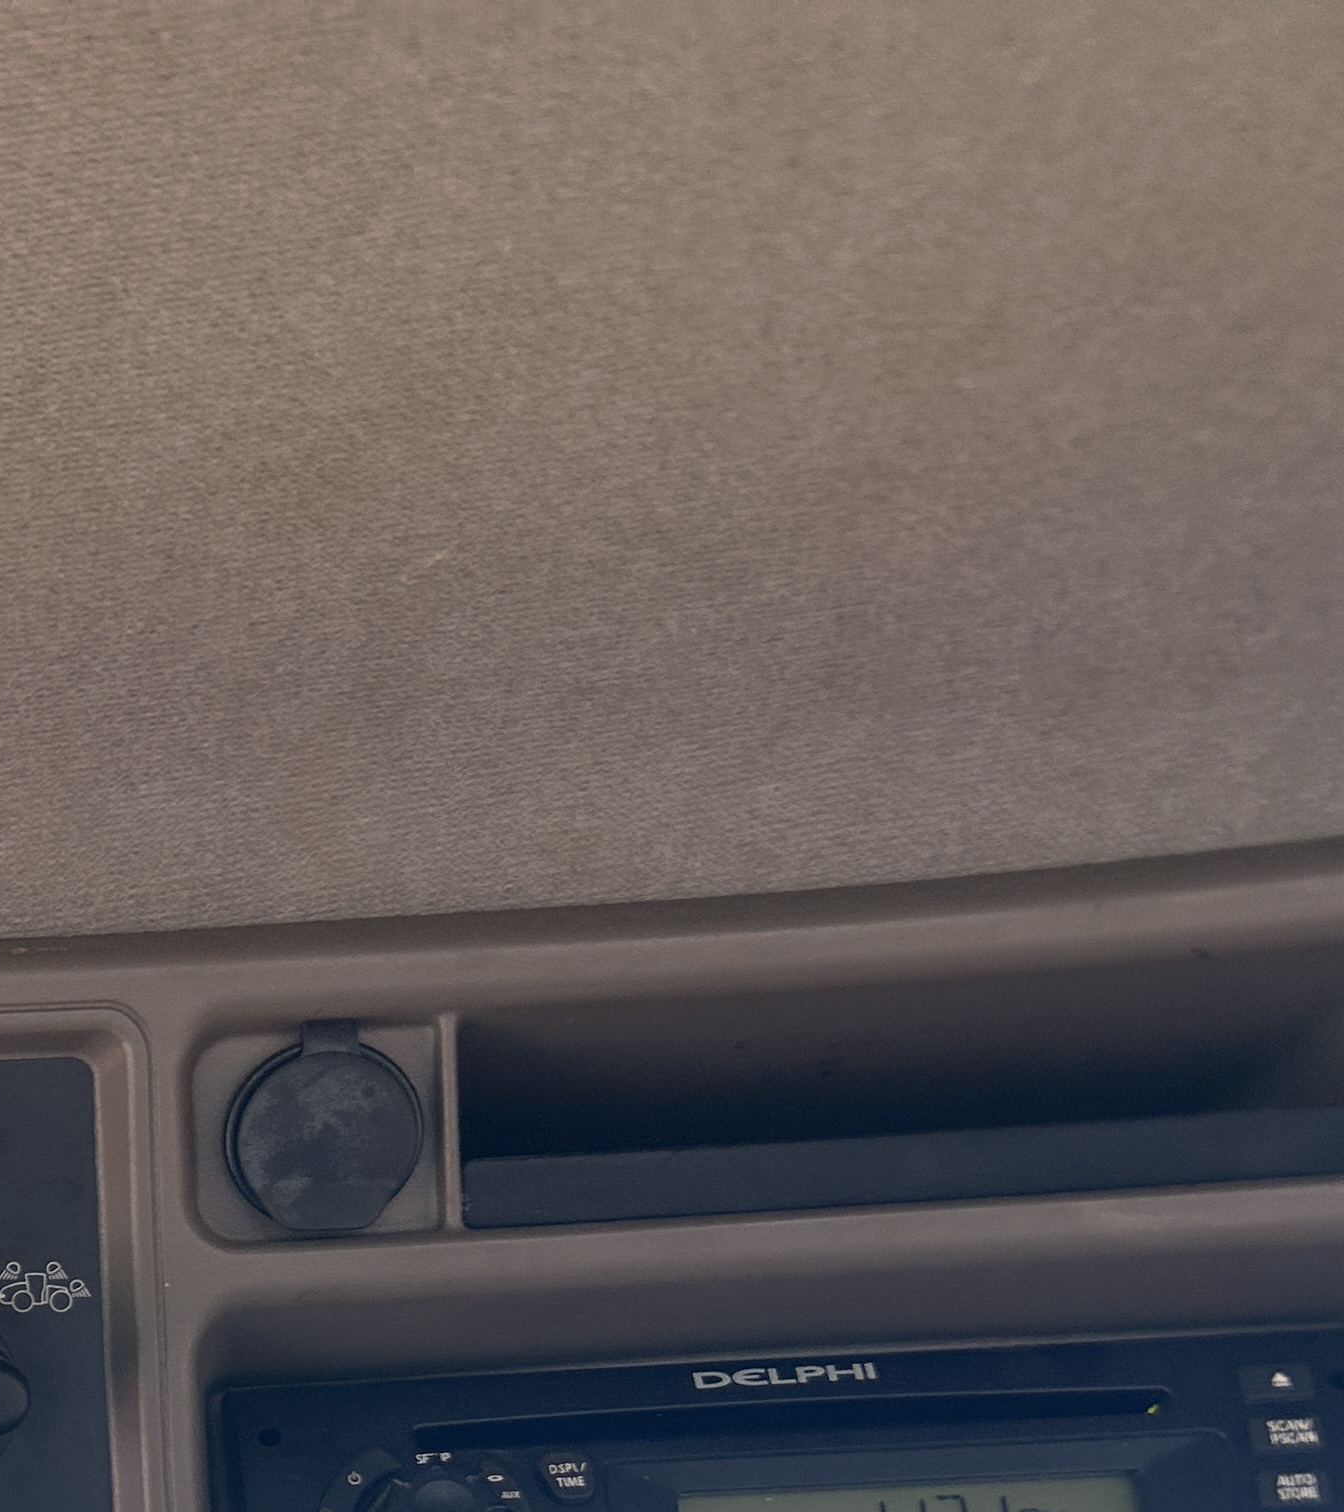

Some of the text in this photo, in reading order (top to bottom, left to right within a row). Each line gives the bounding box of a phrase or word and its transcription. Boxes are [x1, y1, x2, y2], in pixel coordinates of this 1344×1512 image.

[691, 1362, 877, 1390] DELPHI
[556, 1475, 586, 1488] TIME
[1277, 1473, 1318, 1487] AUTO
